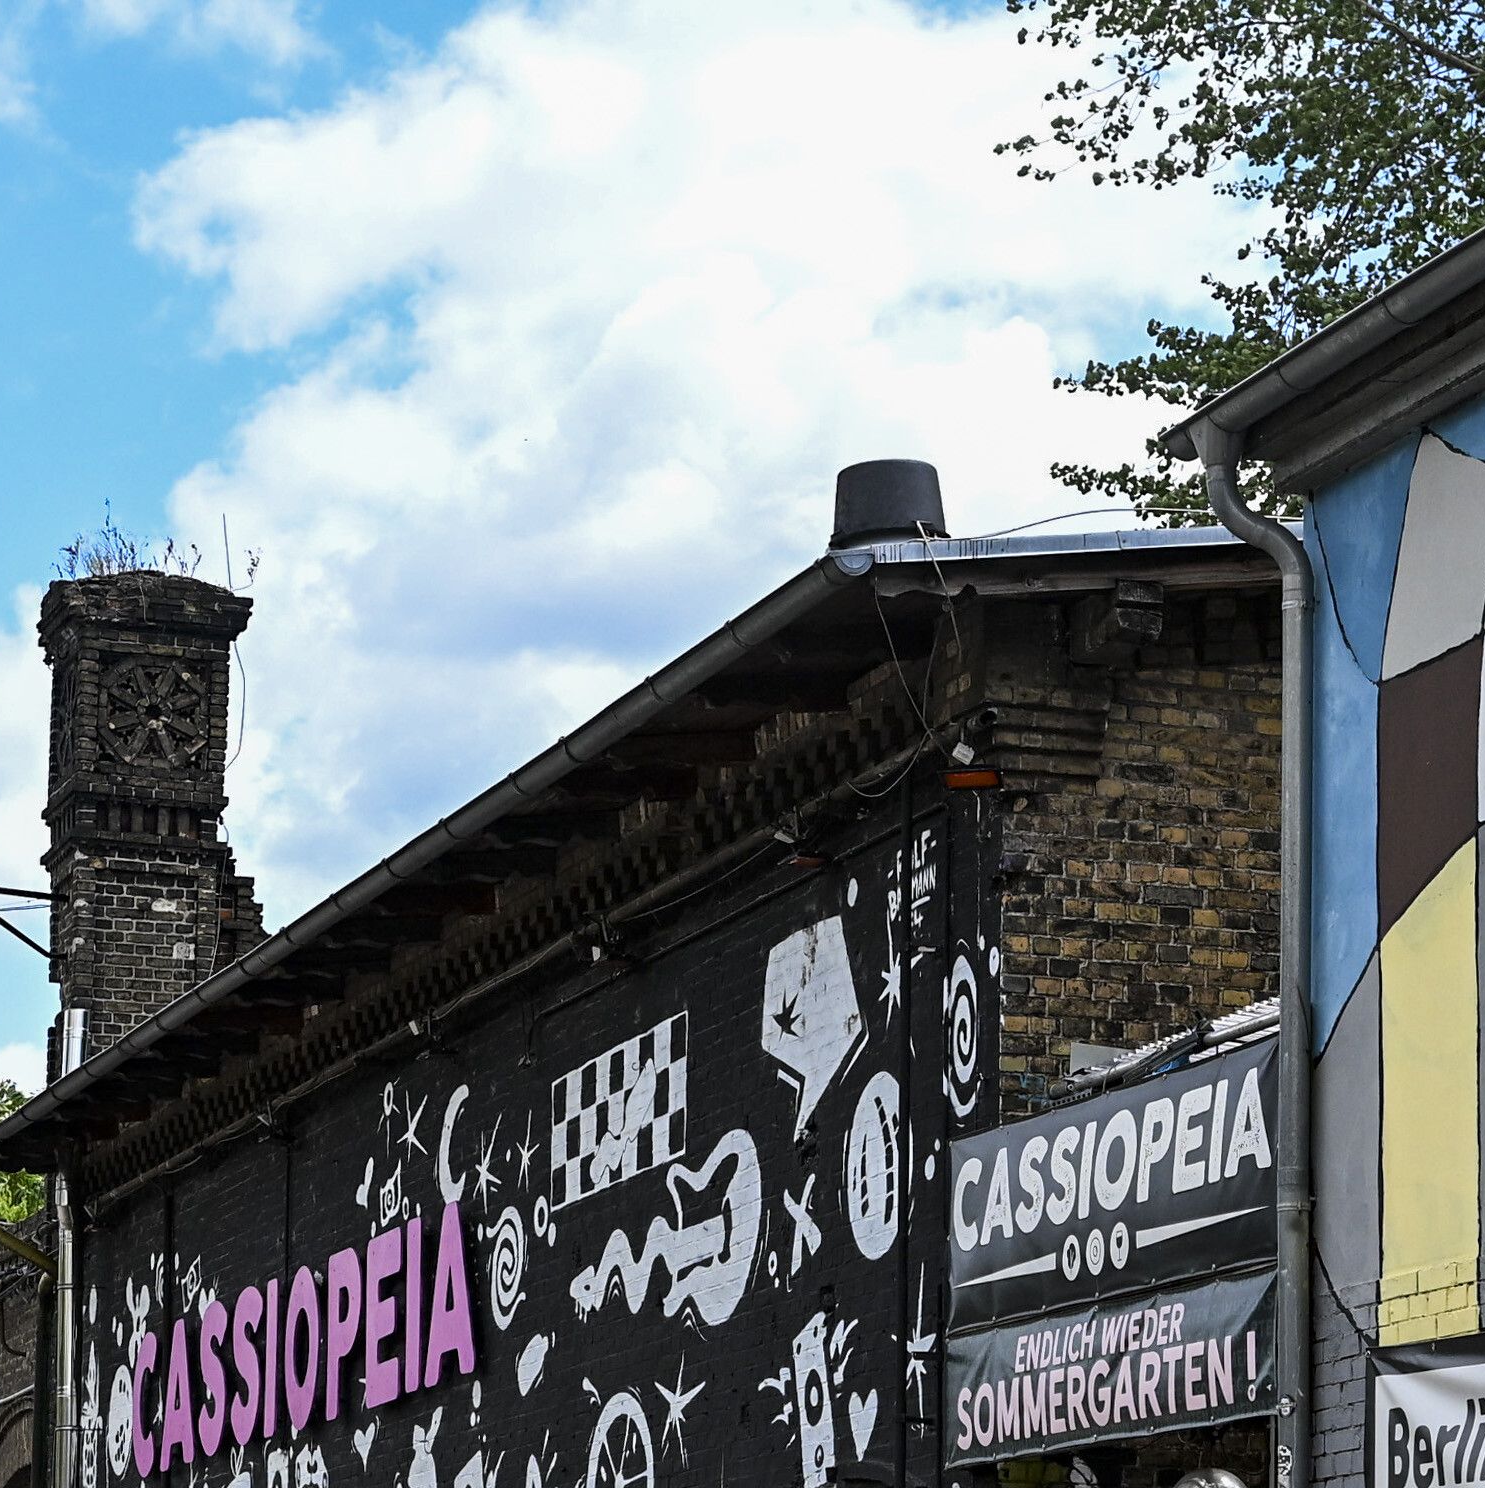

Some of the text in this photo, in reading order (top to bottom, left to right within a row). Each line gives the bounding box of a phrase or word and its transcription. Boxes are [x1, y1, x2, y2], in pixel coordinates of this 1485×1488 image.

[953, 1067, 1272, 1252] CASSIOPEIA
[131, 1201, 475, 1478] CASSIOPEIA
[1014, 1302, 1185, 1373] ENDLICH WIEDER
